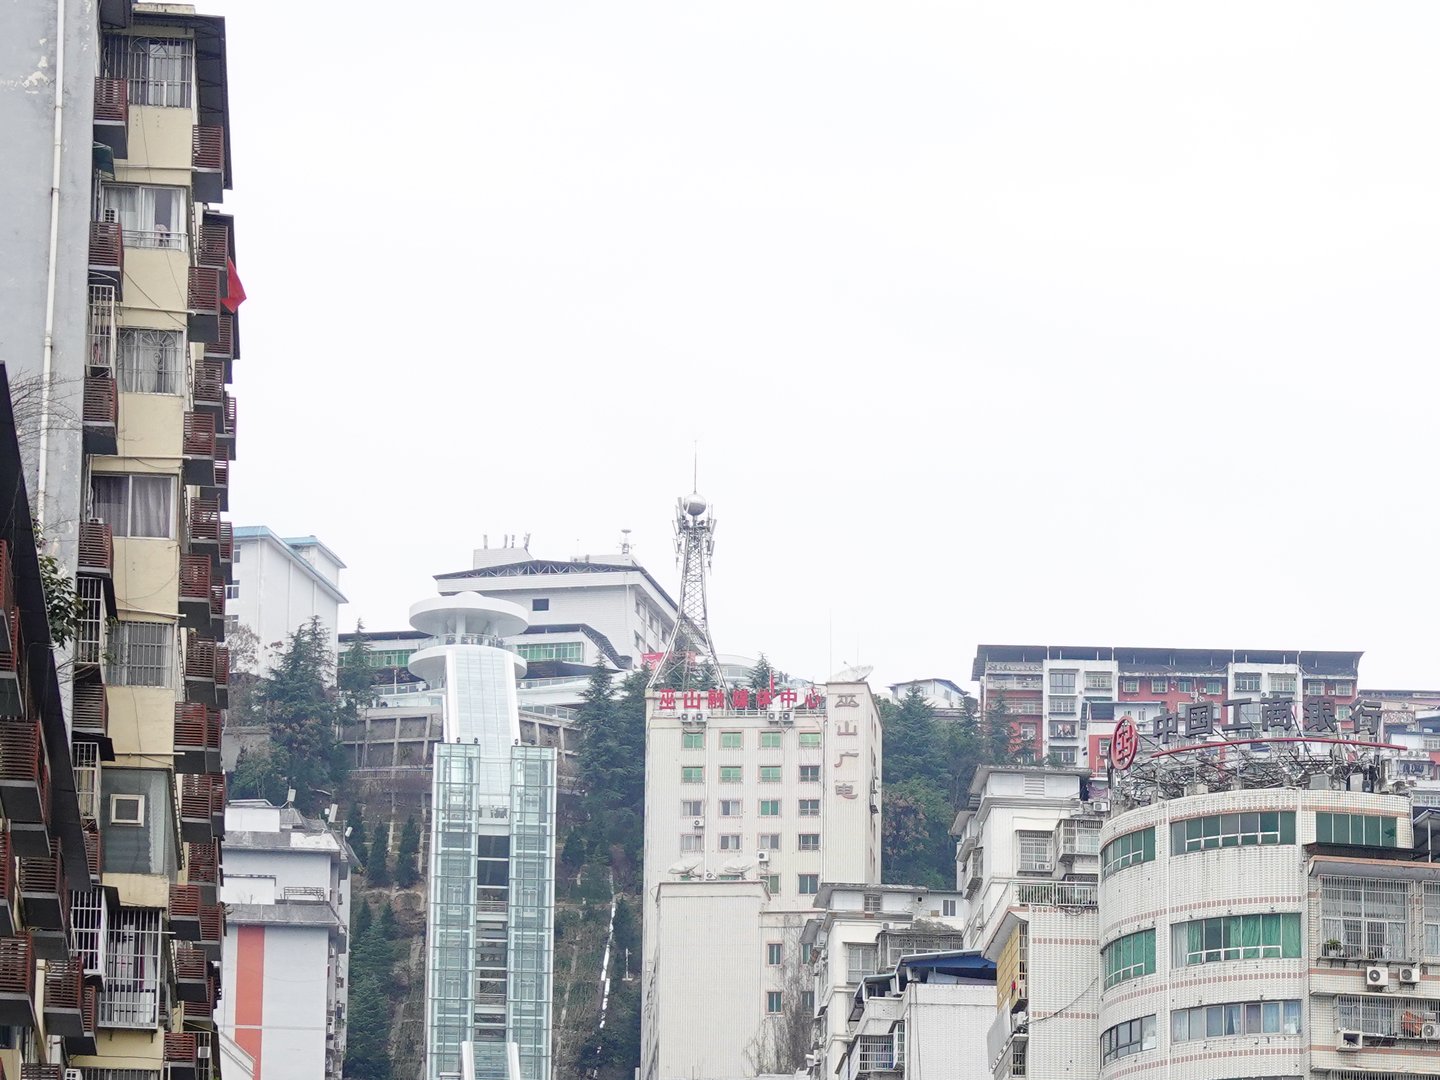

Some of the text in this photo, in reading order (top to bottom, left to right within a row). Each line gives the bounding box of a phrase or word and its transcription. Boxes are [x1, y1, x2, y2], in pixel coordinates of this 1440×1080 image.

[659, 687, 821, 710] 巫山融媒体中心
[834, 693, 860, 800] 巫山广电
